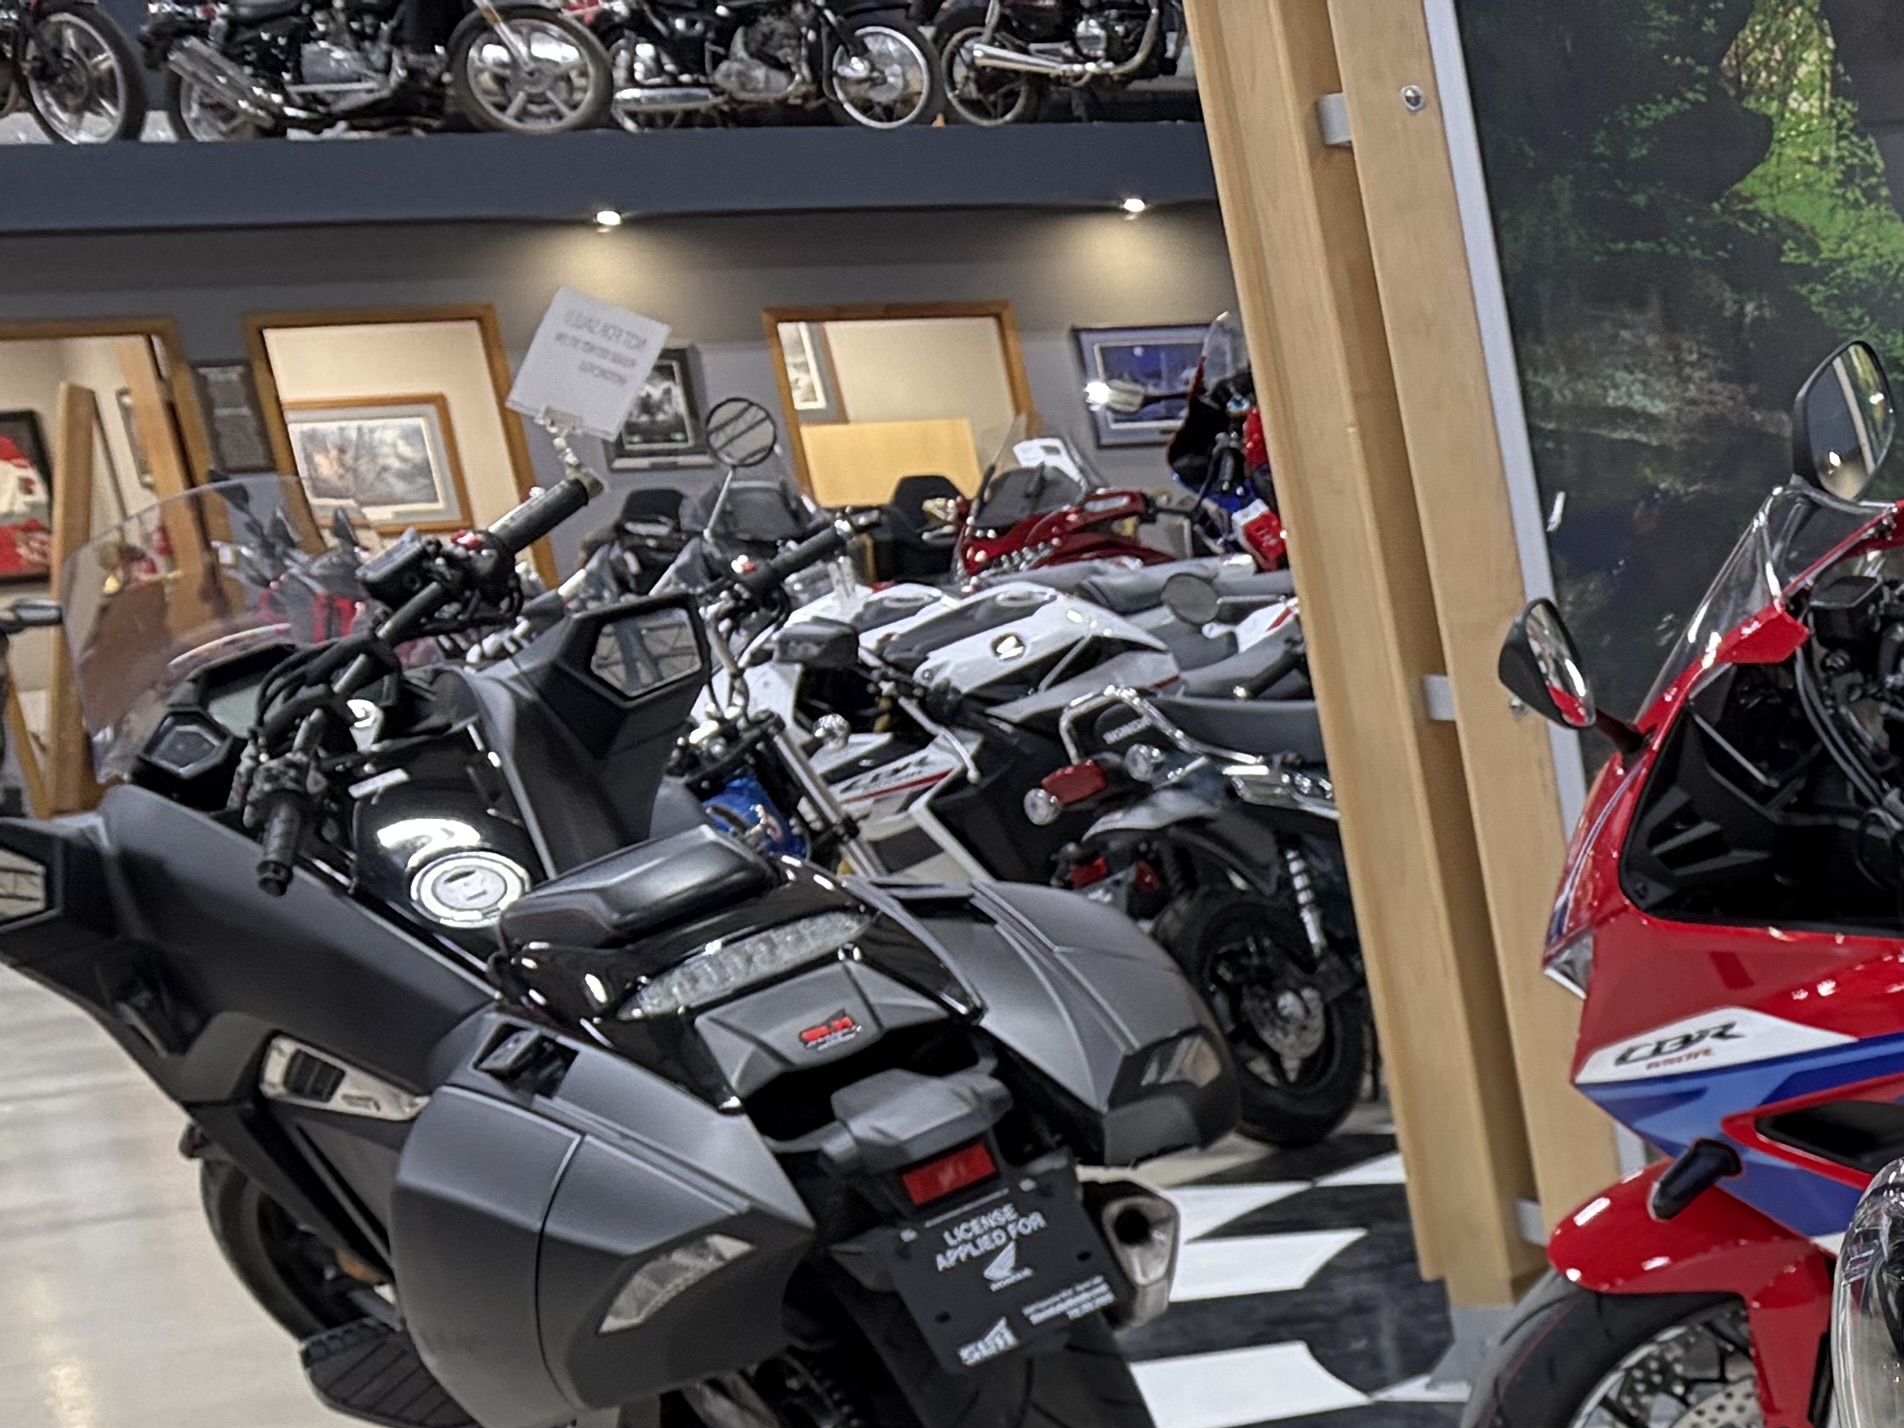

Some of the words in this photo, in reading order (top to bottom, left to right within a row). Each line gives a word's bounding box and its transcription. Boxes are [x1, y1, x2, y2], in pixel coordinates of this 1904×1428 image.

[1614, 1021, 1746, 1066] CBR
[935, 1233, 1007, 1272] APPLIED
[1008, 1211, 1047, 1241] FOR
[943, 1203, 1019, 1245] LICENSE
